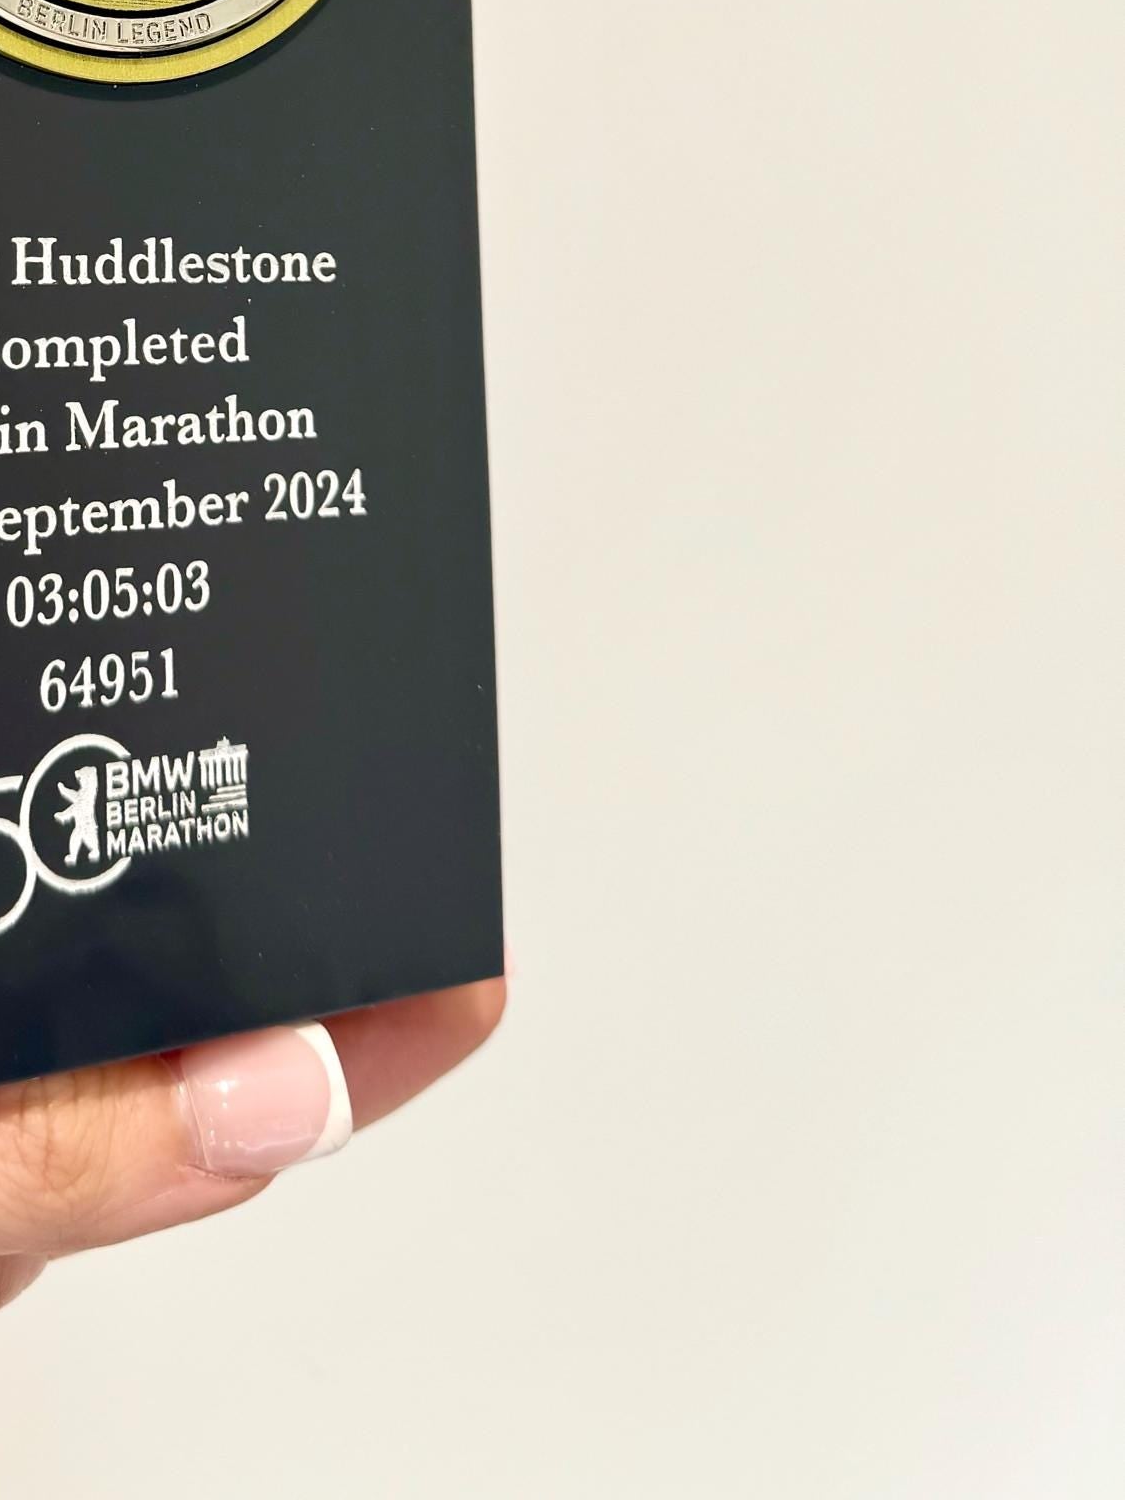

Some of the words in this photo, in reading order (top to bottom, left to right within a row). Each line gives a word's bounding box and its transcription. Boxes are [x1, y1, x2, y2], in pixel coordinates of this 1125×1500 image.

[116, 12, 213, 45] LEGEND
[11, 236, 338, 288] Huddlestone
[65, 394, 317, 451] Marathon
[263, 468, 368, 521] 2024
[6, 559, 211, 627] 03:05:03
[39, 647, 179, 712] 64951
[105, 751, 195, 800] BMW
[105, 790, 197, 830] BERLIN
[105, 810, 250, 860] MARATHON
